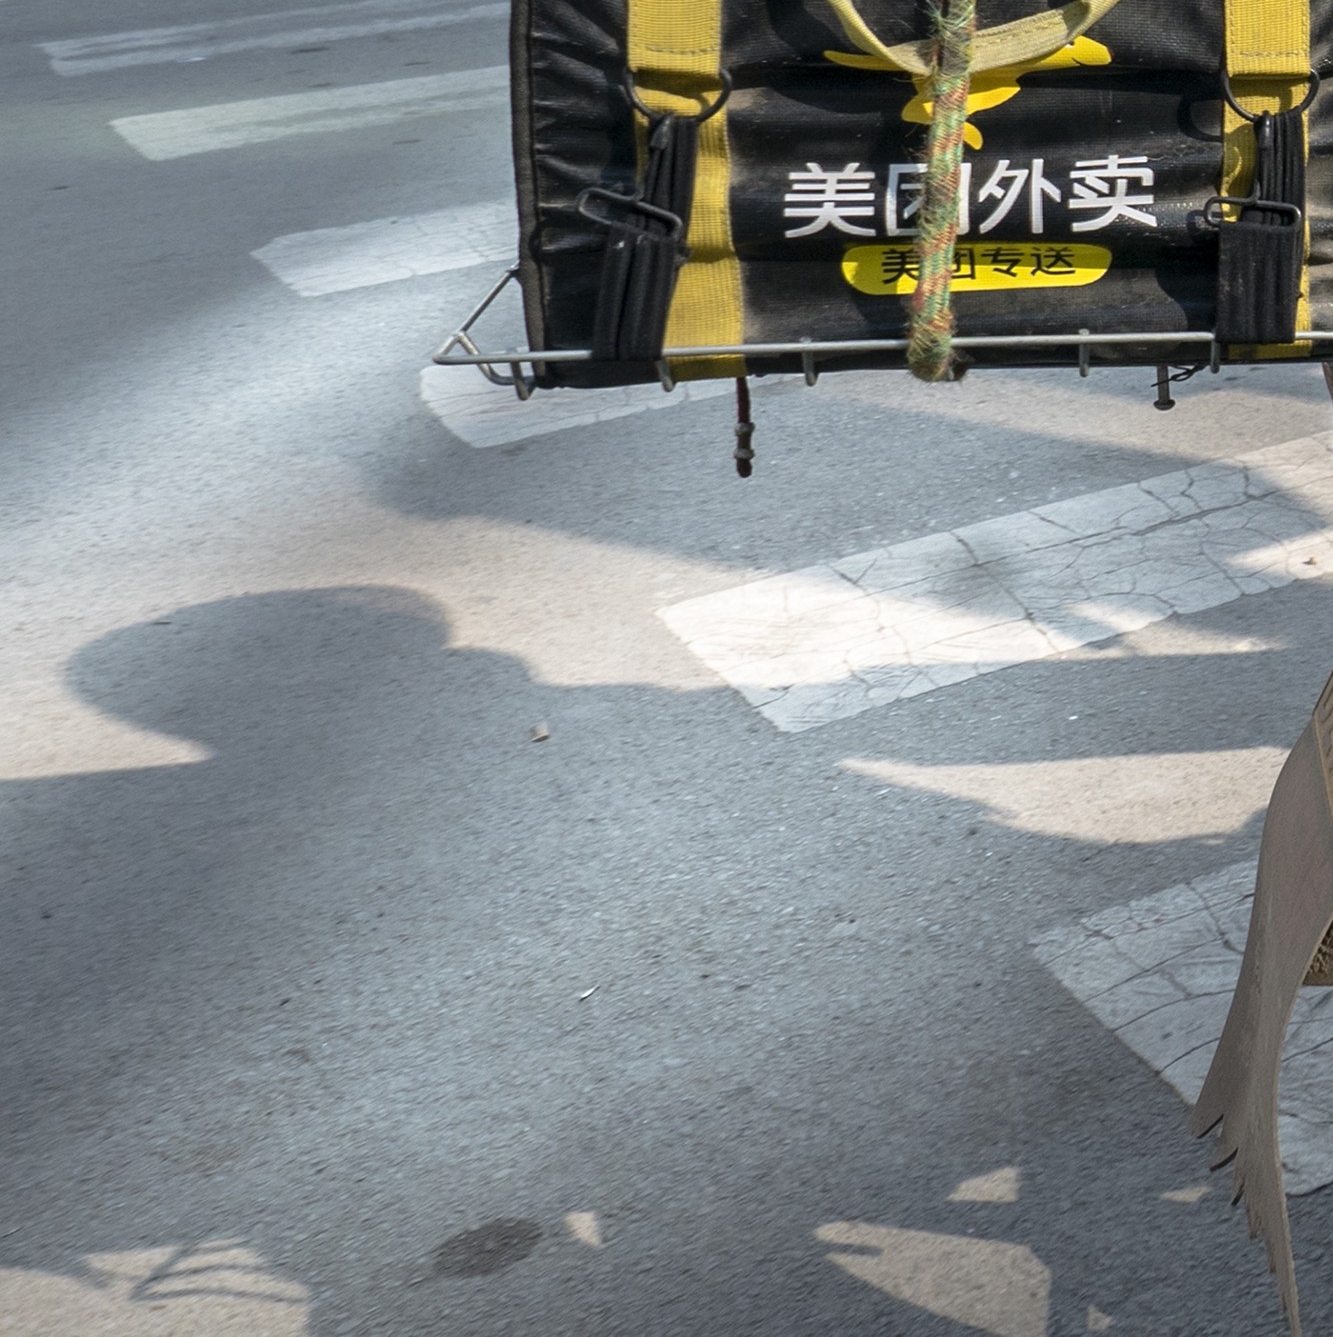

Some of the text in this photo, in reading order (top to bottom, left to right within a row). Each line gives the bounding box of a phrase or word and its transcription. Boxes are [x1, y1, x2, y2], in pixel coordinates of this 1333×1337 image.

[784, 155, 1157, 239] 美团外卖
[881, 246, 1077, 285] 美团专送
